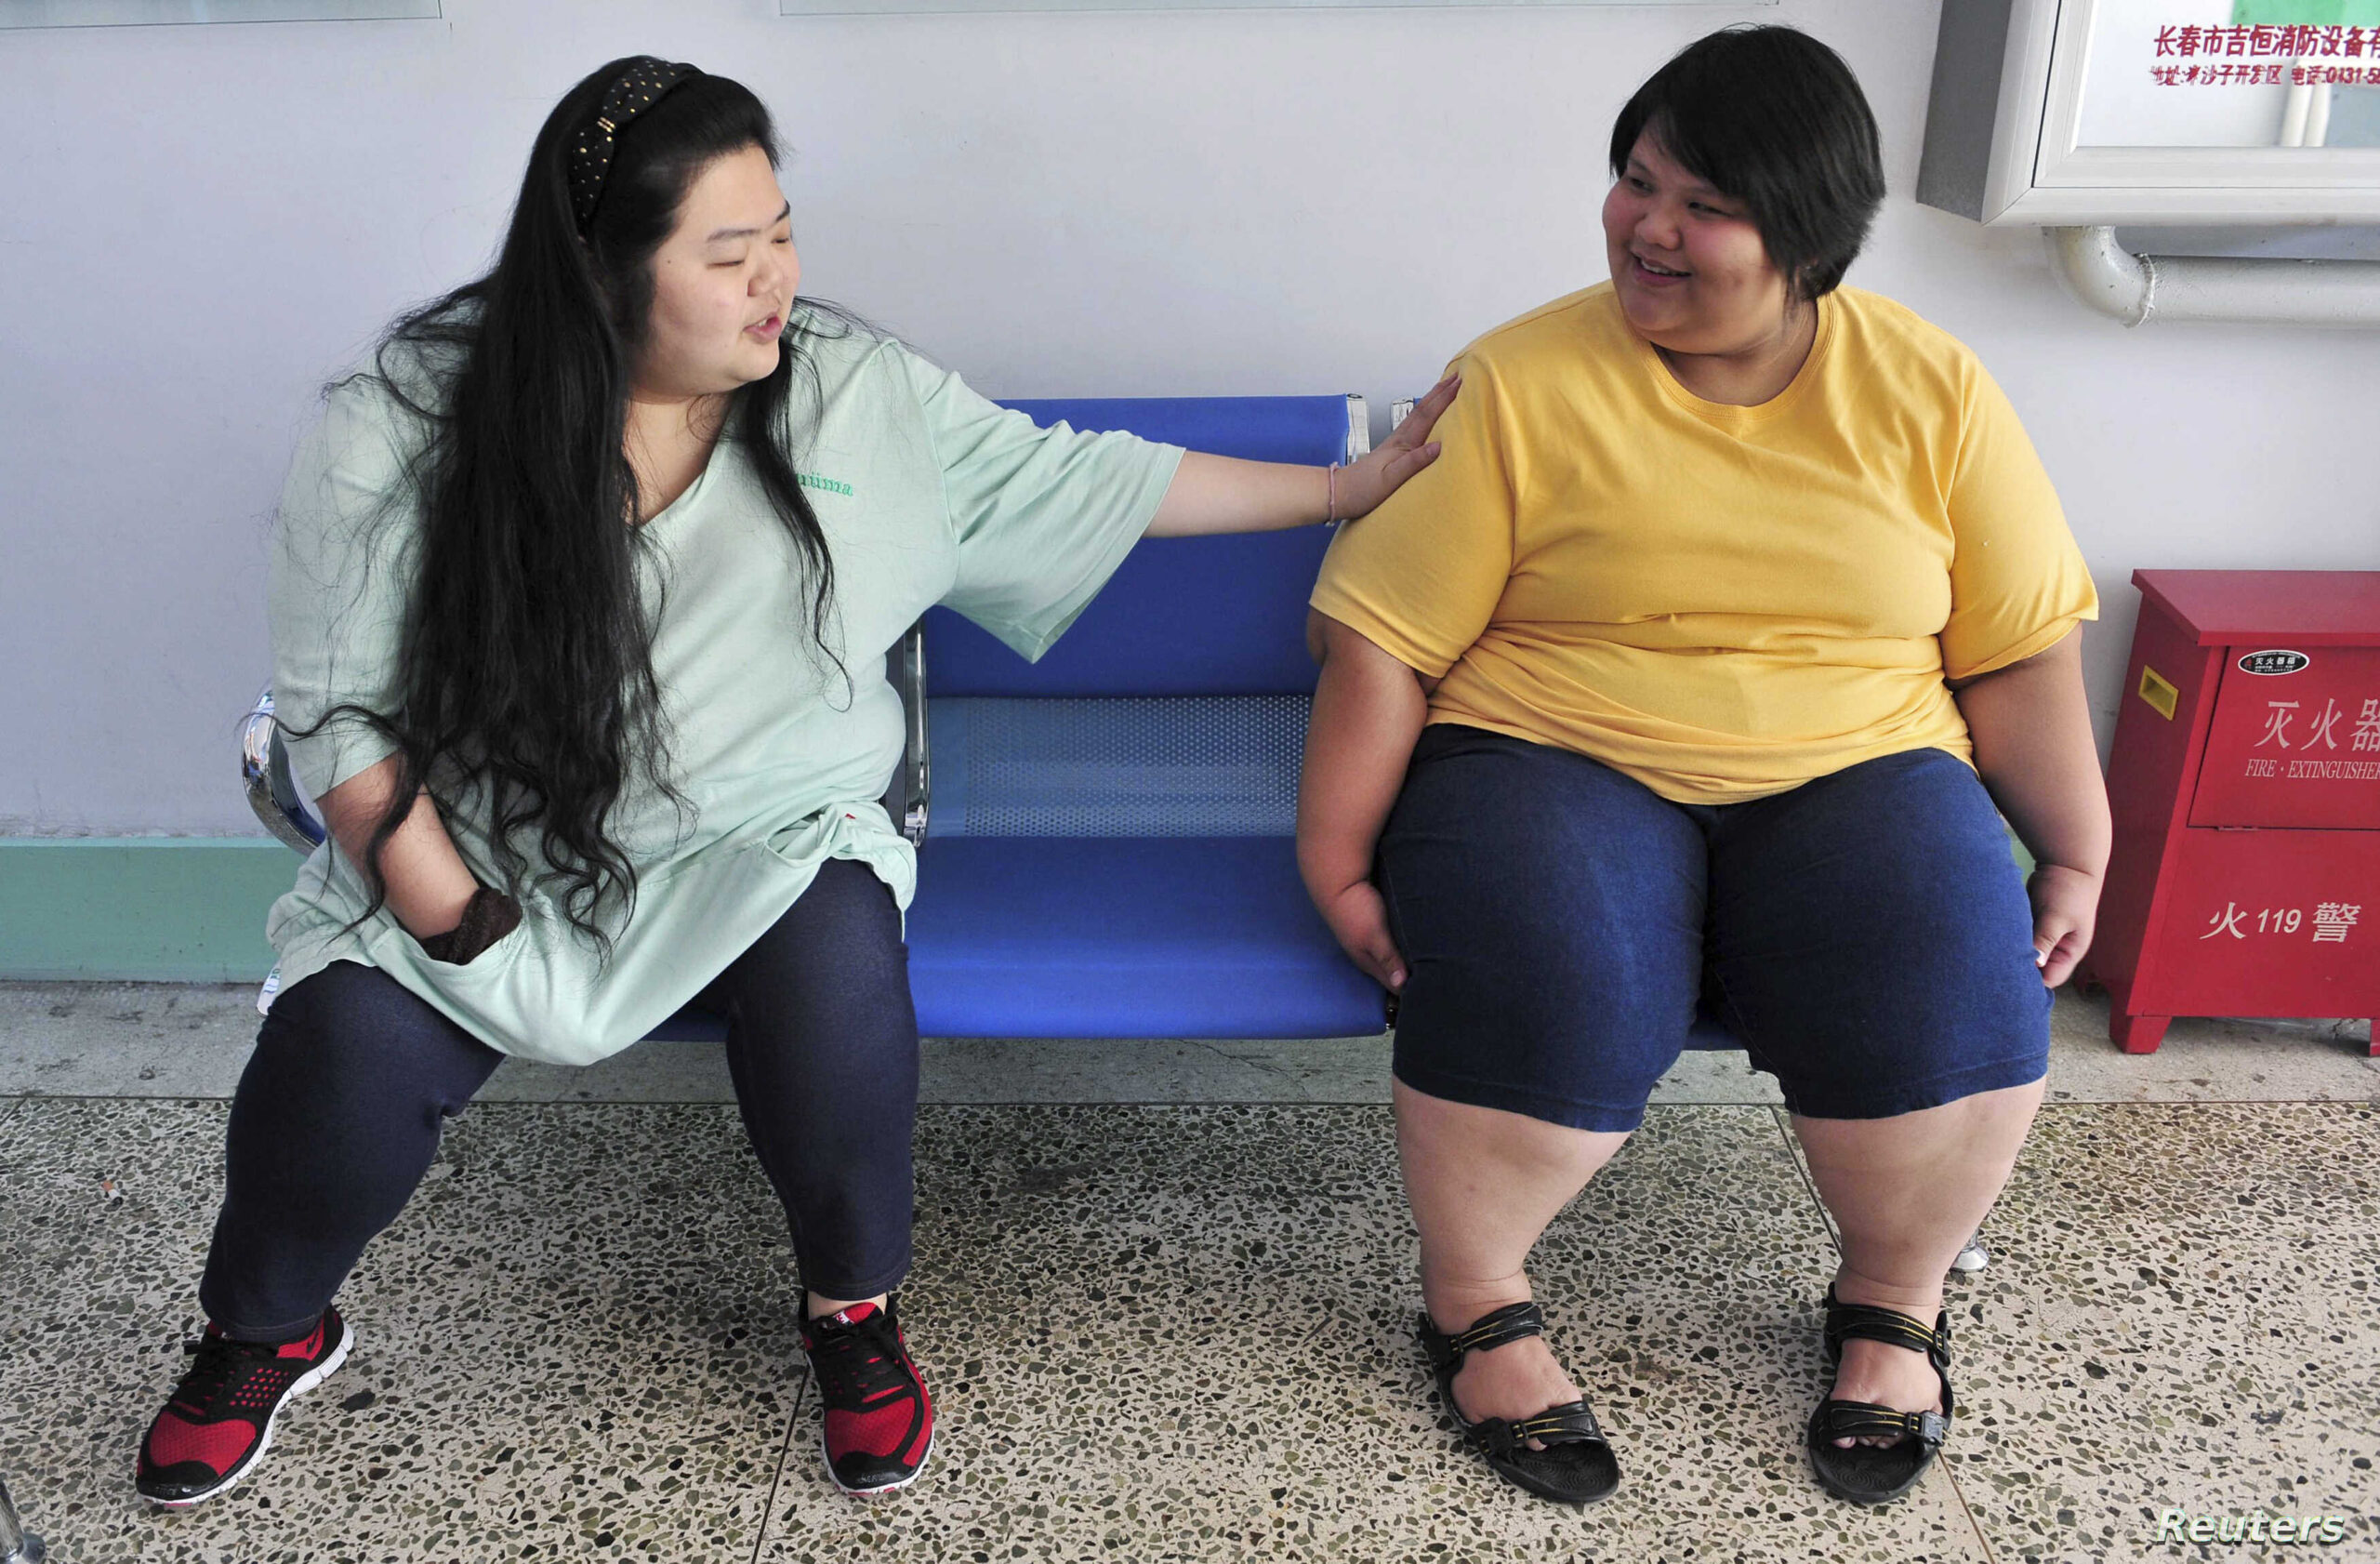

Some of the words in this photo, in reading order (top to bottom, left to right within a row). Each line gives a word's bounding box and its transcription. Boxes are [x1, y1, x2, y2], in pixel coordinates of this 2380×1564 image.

[2245, 758, 2277, 777] FIRE
[2199, 901, 2248, 940] 火
[2257, 908, 2302, 934] 119
[2312, 901, 2362, 943] 警
